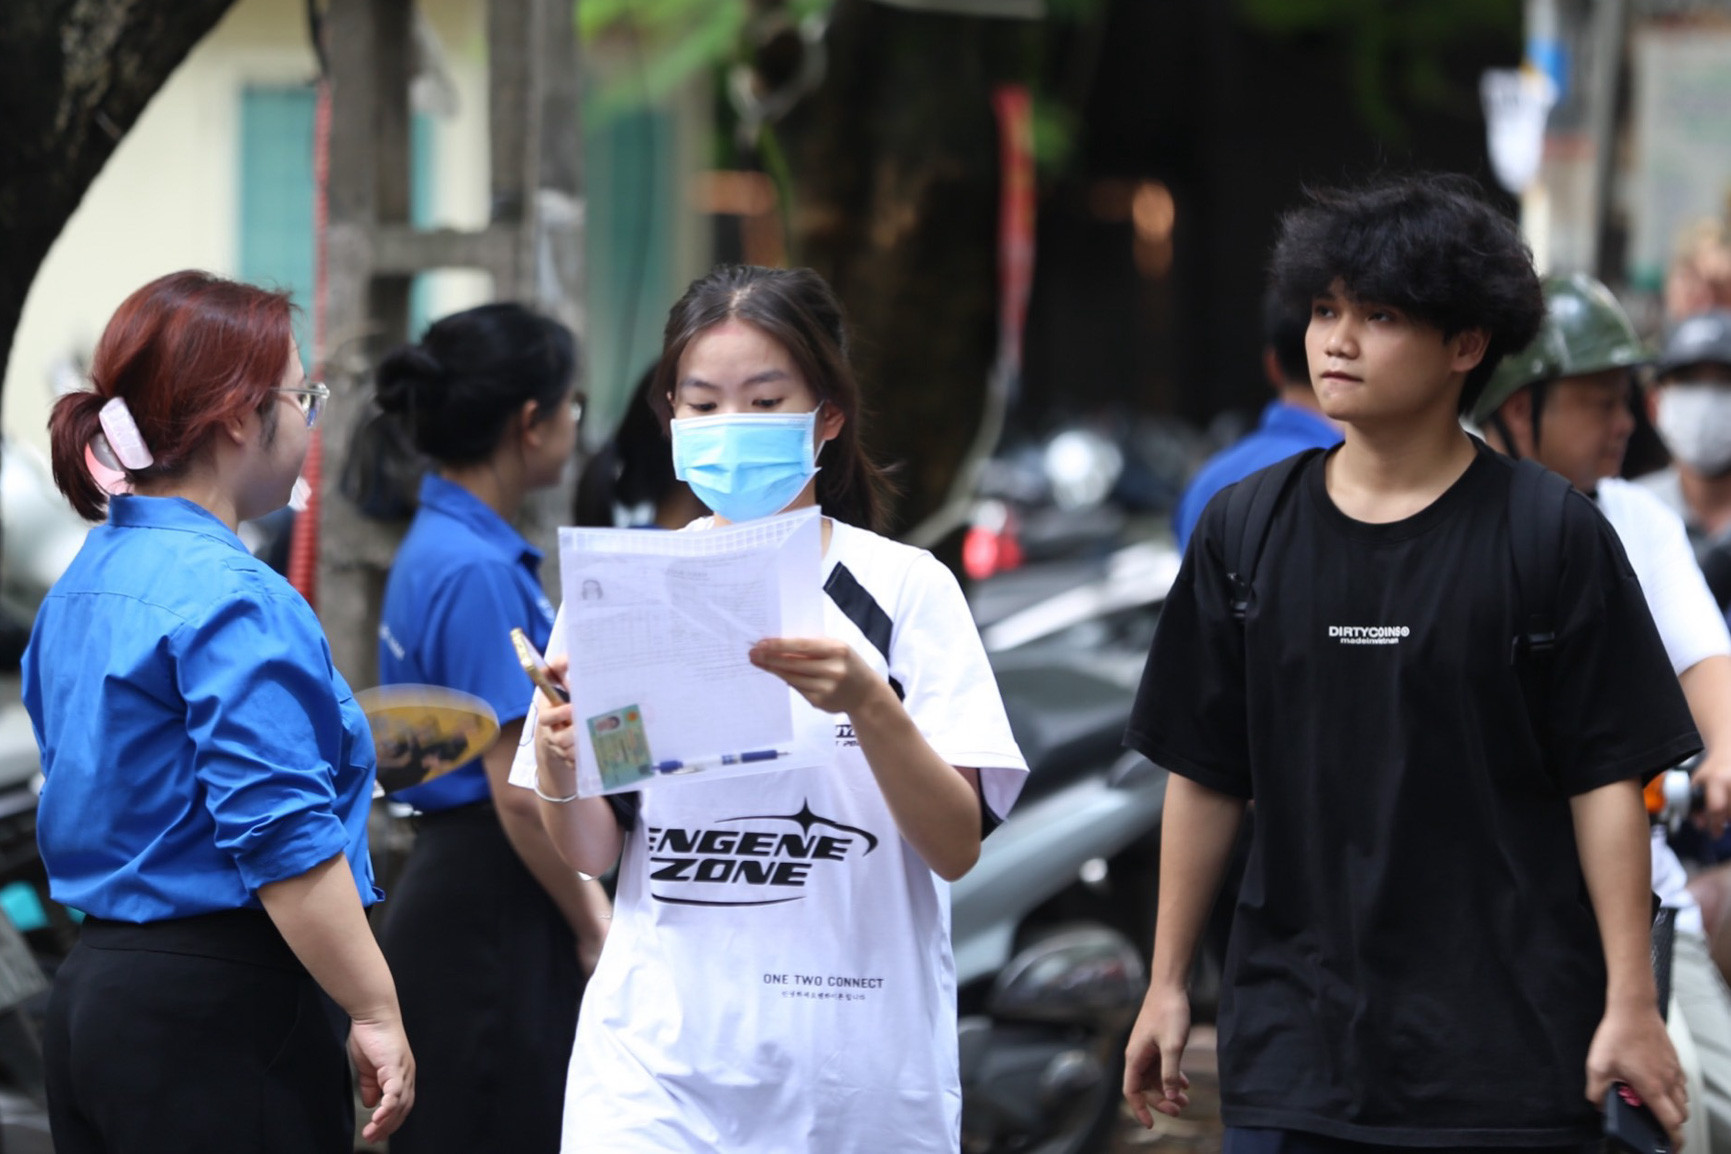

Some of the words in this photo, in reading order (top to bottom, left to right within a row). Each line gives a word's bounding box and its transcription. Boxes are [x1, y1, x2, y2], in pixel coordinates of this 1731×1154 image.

[1328, 626, 1400, 637] DIRTYCOINS
[649, 857, 813, 886] ZONE
[763, 974, 789, 984] ONE
[794, 975, 822, 986] TWO
[827, 977, 884, 989] CONNECT
